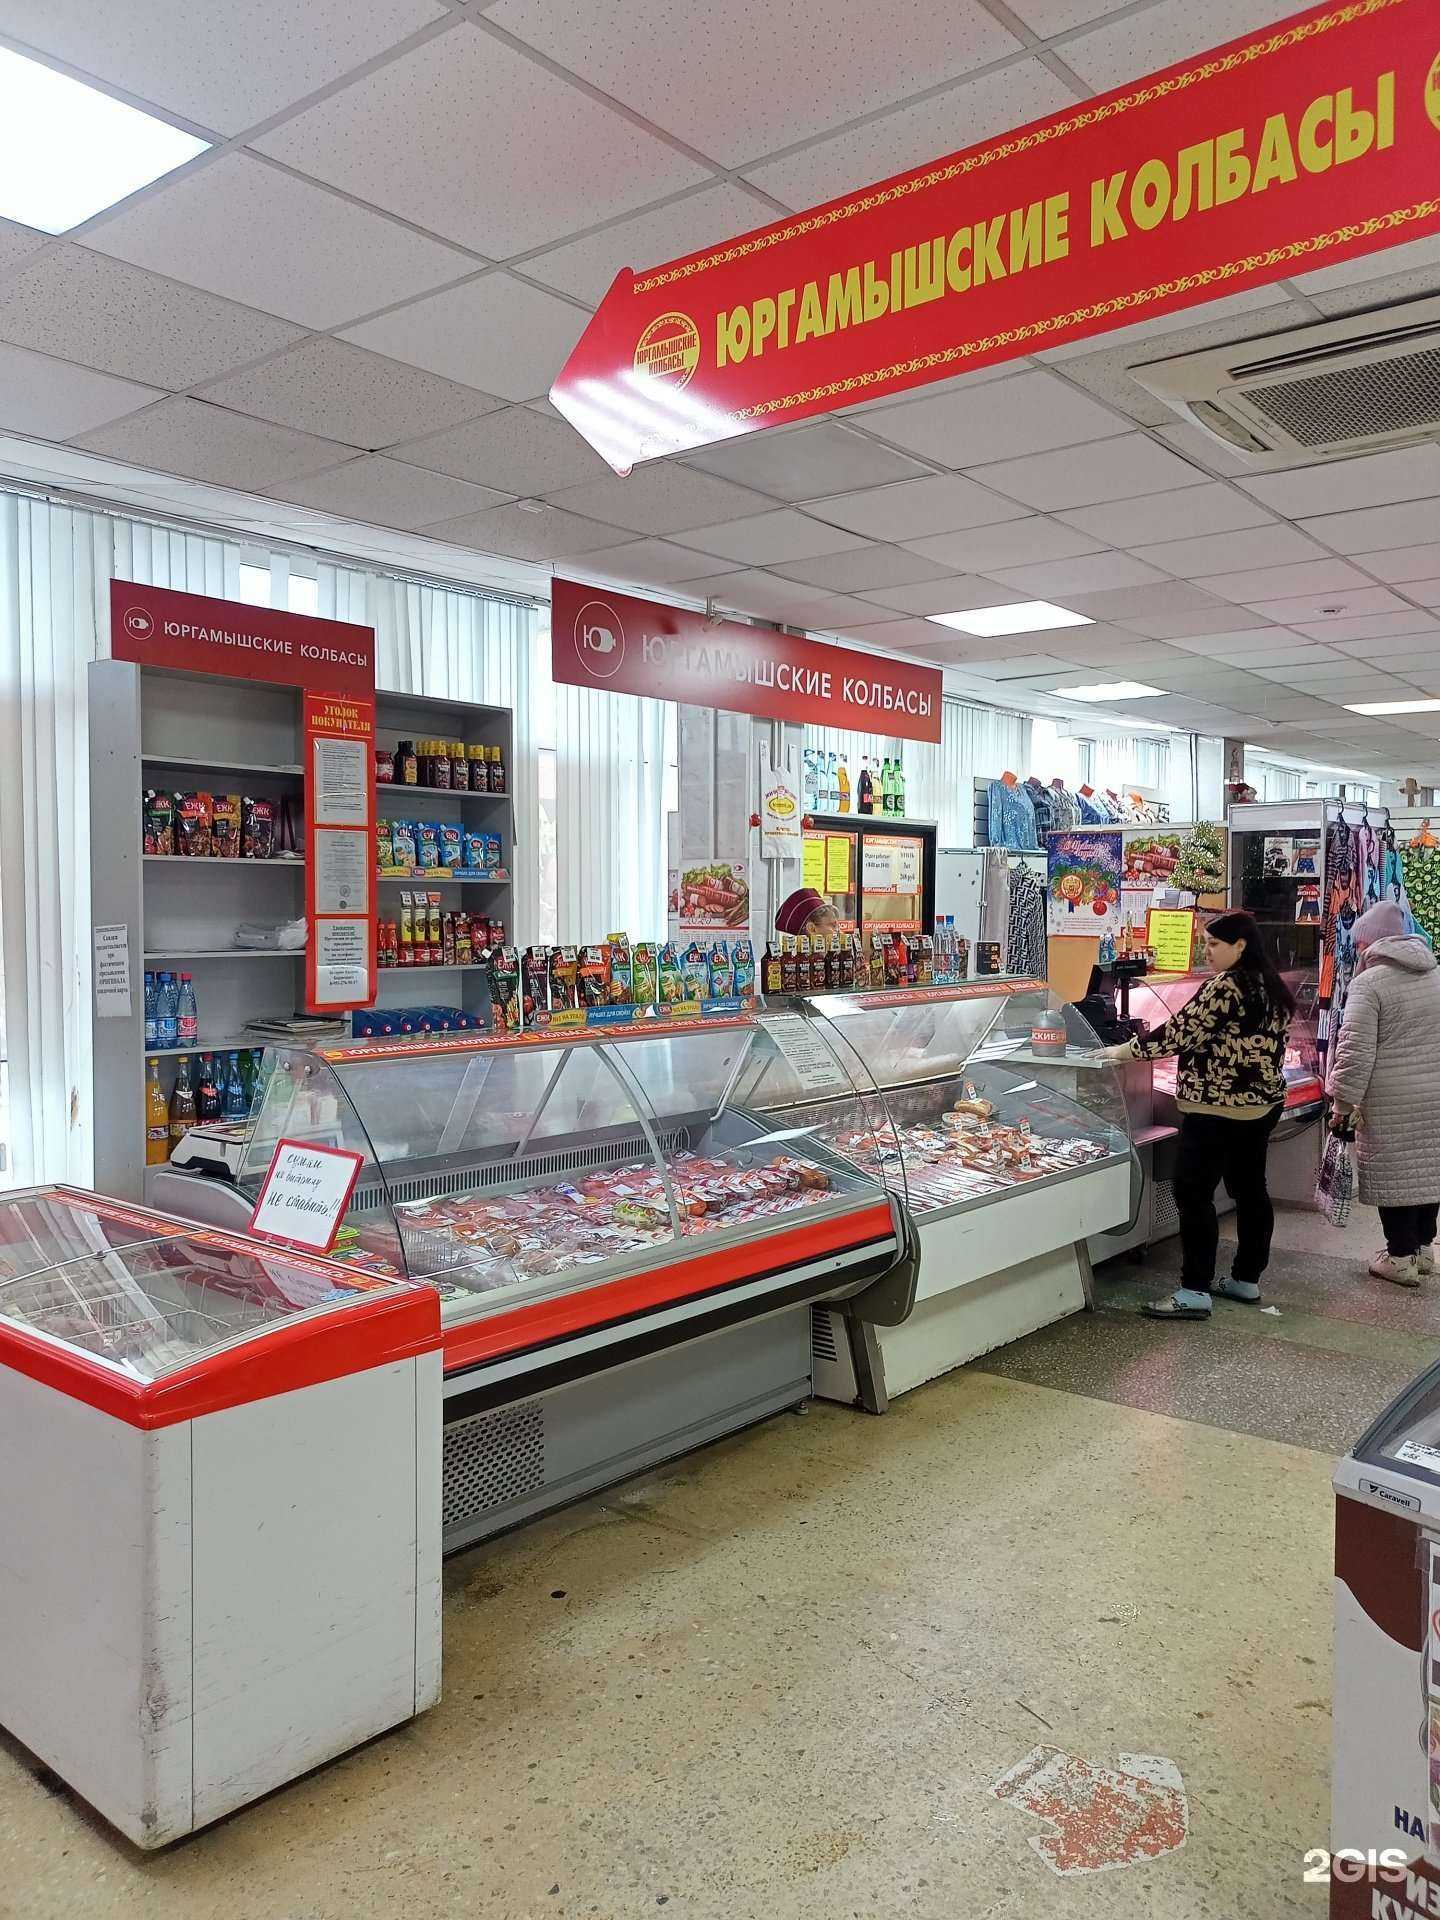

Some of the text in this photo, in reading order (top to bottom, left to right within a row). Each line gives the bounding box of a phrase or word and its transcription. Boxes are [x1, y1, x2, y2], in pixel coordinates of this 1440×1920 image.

[716, 71, 1395, 368] ЮРГАМЫШСКИЕ КОЛБАСЫ
[636, 333, 697, 365] ЮРГАМЫШСКИЕ
[648, 352, 684, 376] КОЛБАСЫ
[164, 621, 368, 667] ЮРГАМЫШСКИЕ КОЛБАСЫ
[843, 676, 932, 717] КОЛБАСЫ
[1379, 1490, 1411, 1507] Caravell
